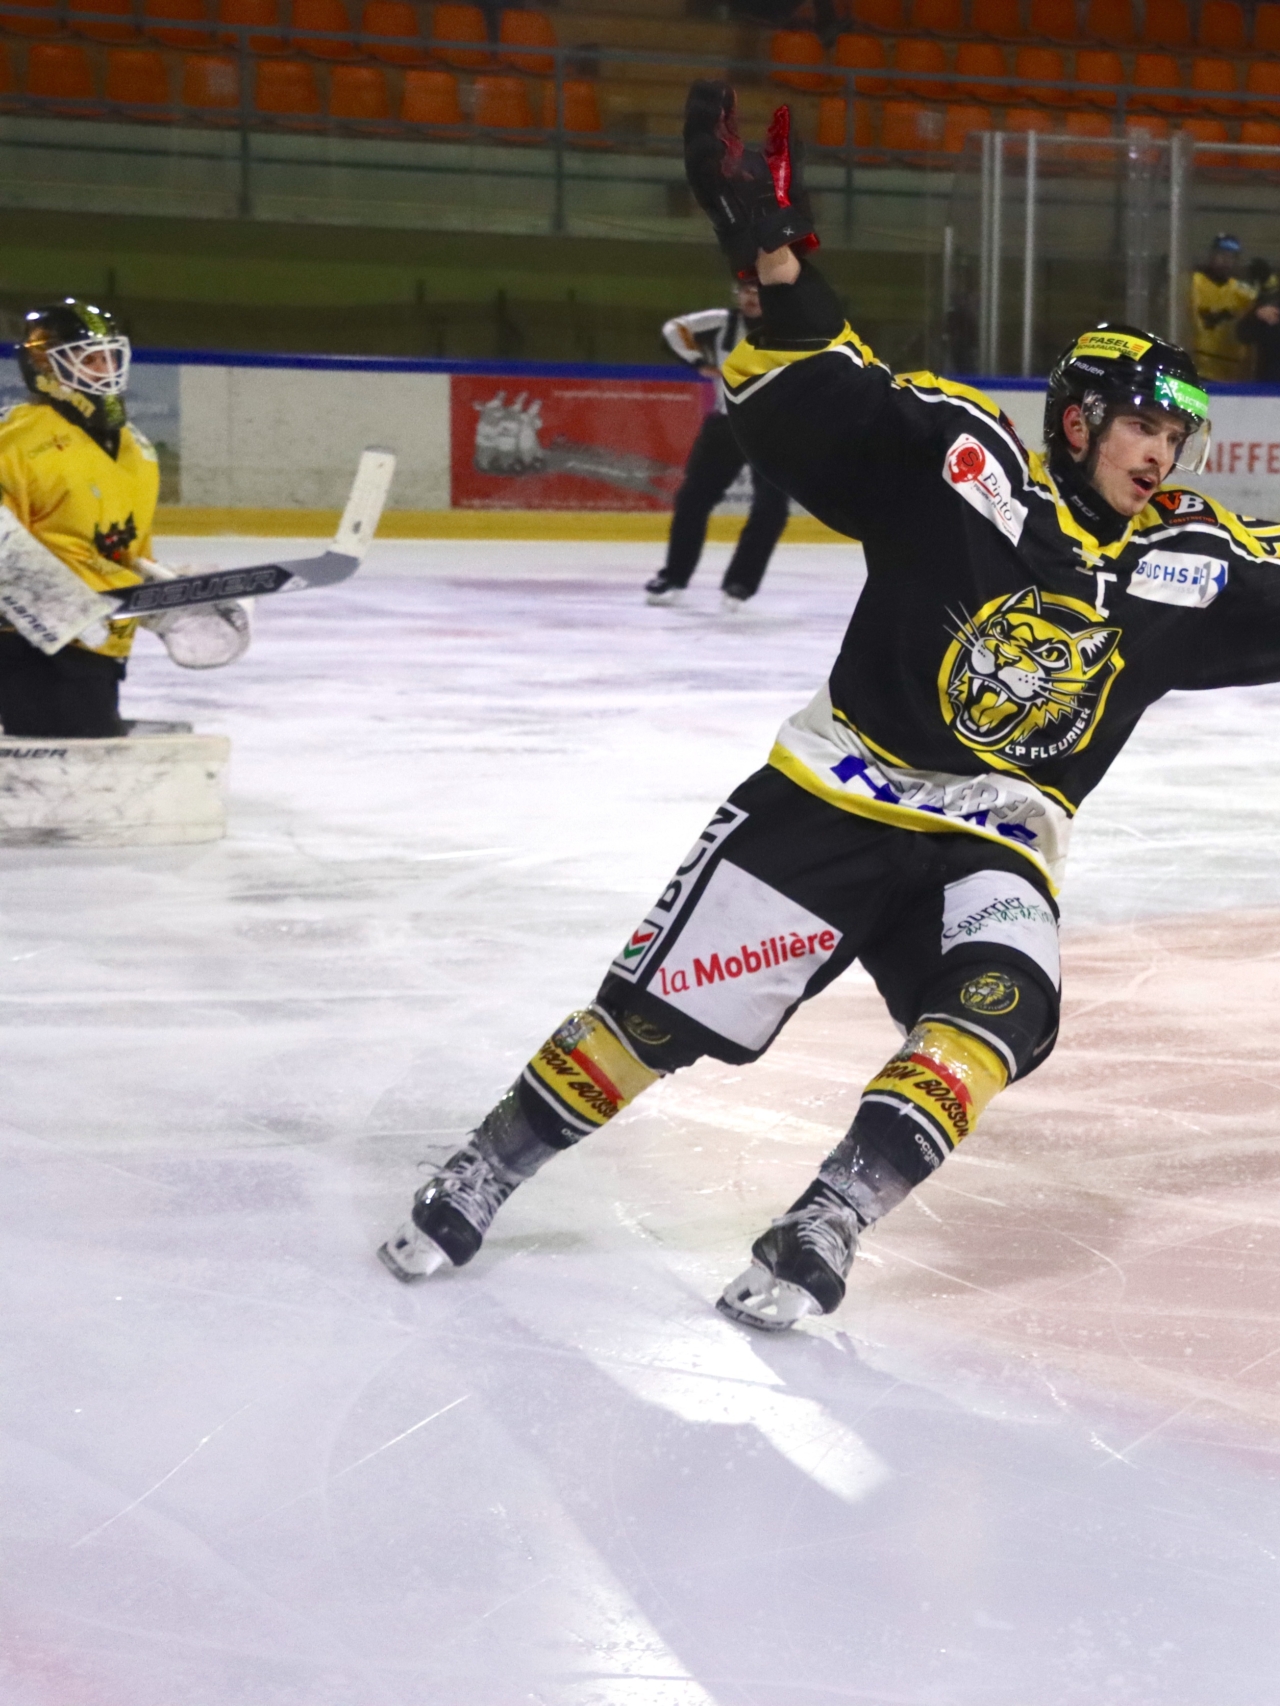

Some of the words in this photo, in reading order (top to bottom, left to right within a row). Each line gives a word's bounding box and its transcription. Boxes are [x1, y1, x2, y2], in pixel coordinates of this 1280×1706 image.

[1088, 335, 1131, 350] FASEL
[982, 472, 1014, 522] Pinto
[1155, 491, 1205, 515] VB
[129, 567, 278, 611] BAUER
[1136, 560, 1190, 585] BUCHS
[1030, 707, 1092, 760] FLEURIER
[942, 896, 1025, 939] Courrier
[657, 966, 691, 996] la
[692, 928, 836, 987] Mobilière
